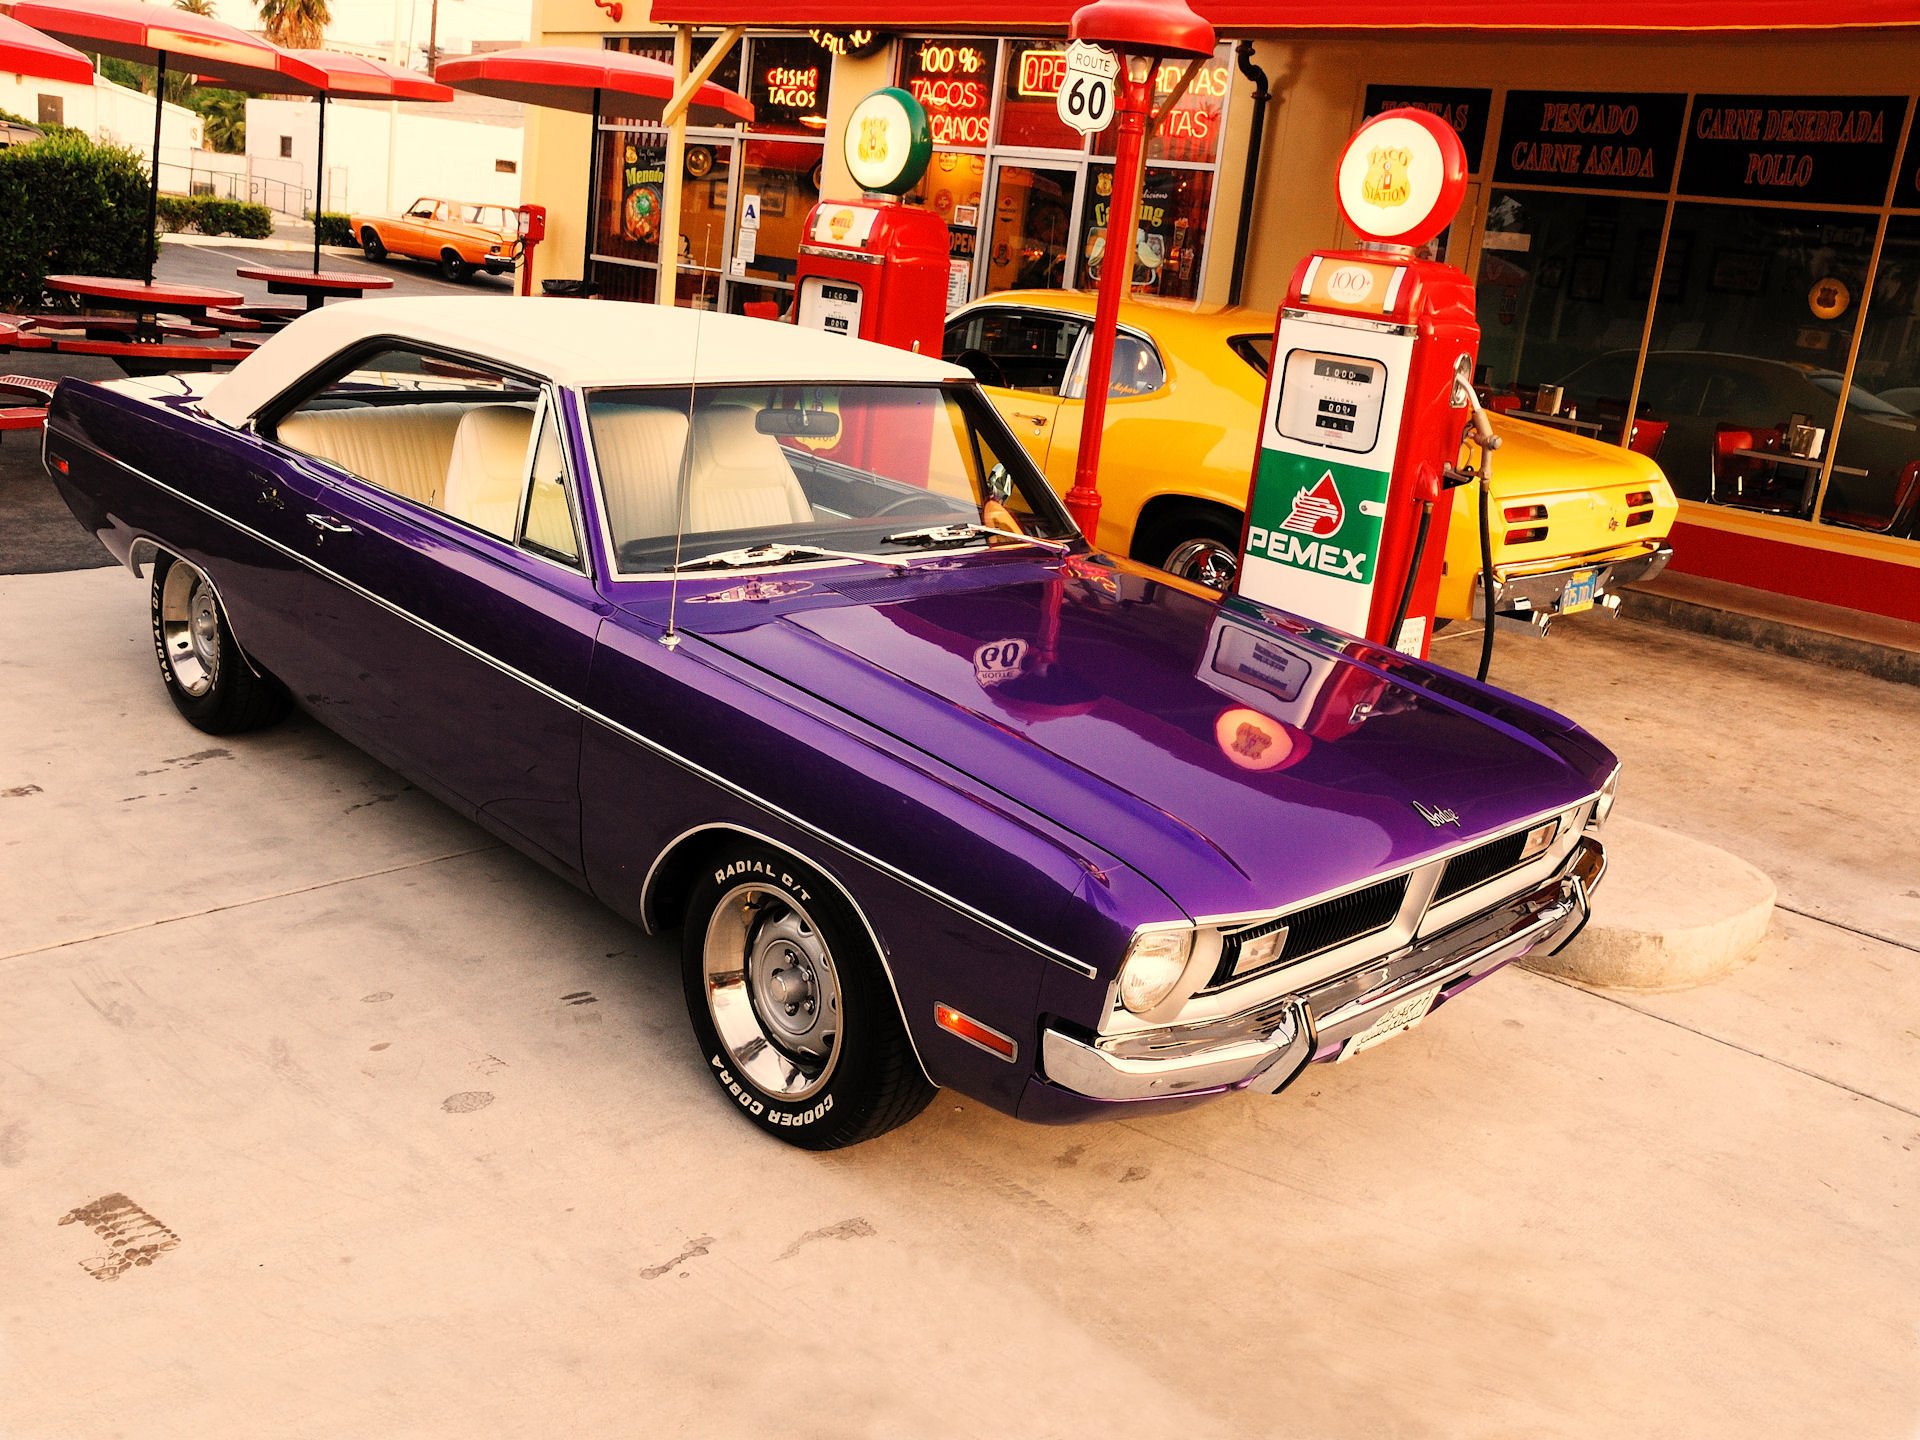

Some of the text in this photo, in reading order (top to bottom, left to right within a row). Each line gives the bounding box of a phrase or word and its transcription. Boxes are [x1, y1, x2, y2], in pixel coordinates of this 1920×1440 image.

[920, 46, 978, 73] 100 %
[1024, 56, 1067, 91] OPE
[1076, 53, 1111, 73] ROUTE
[775, 68, 809, 88] FISH
[767, 86, 816, 108] TACOS
[910, 80, 978, 108] TACOS
[1068, 77, 1106, 120] 60
[930, 114, 990, 142] CANOS
[1540, 102, 1639, 136] PESCADO
[1696, 107, 1884, 144] CARNE DESEBRADA
[1371, 149, 1409, 167] TACO
[1511, 141, 1655, 179] CARNE ASADA
[1744, 152, 1814, 188] POLLO
[625, 167, 665, 187] Menudo
[1364, 180, 1409, 202] STATION
[744, 204, 757, 219] A
[1246, 525, 1367, 580] PEMEX
[714, 860, 812, 902] RADIAL G/T
[711, 1053, 764, 1116] COBRA
[767, 1093, 834, 1127] COOPER
